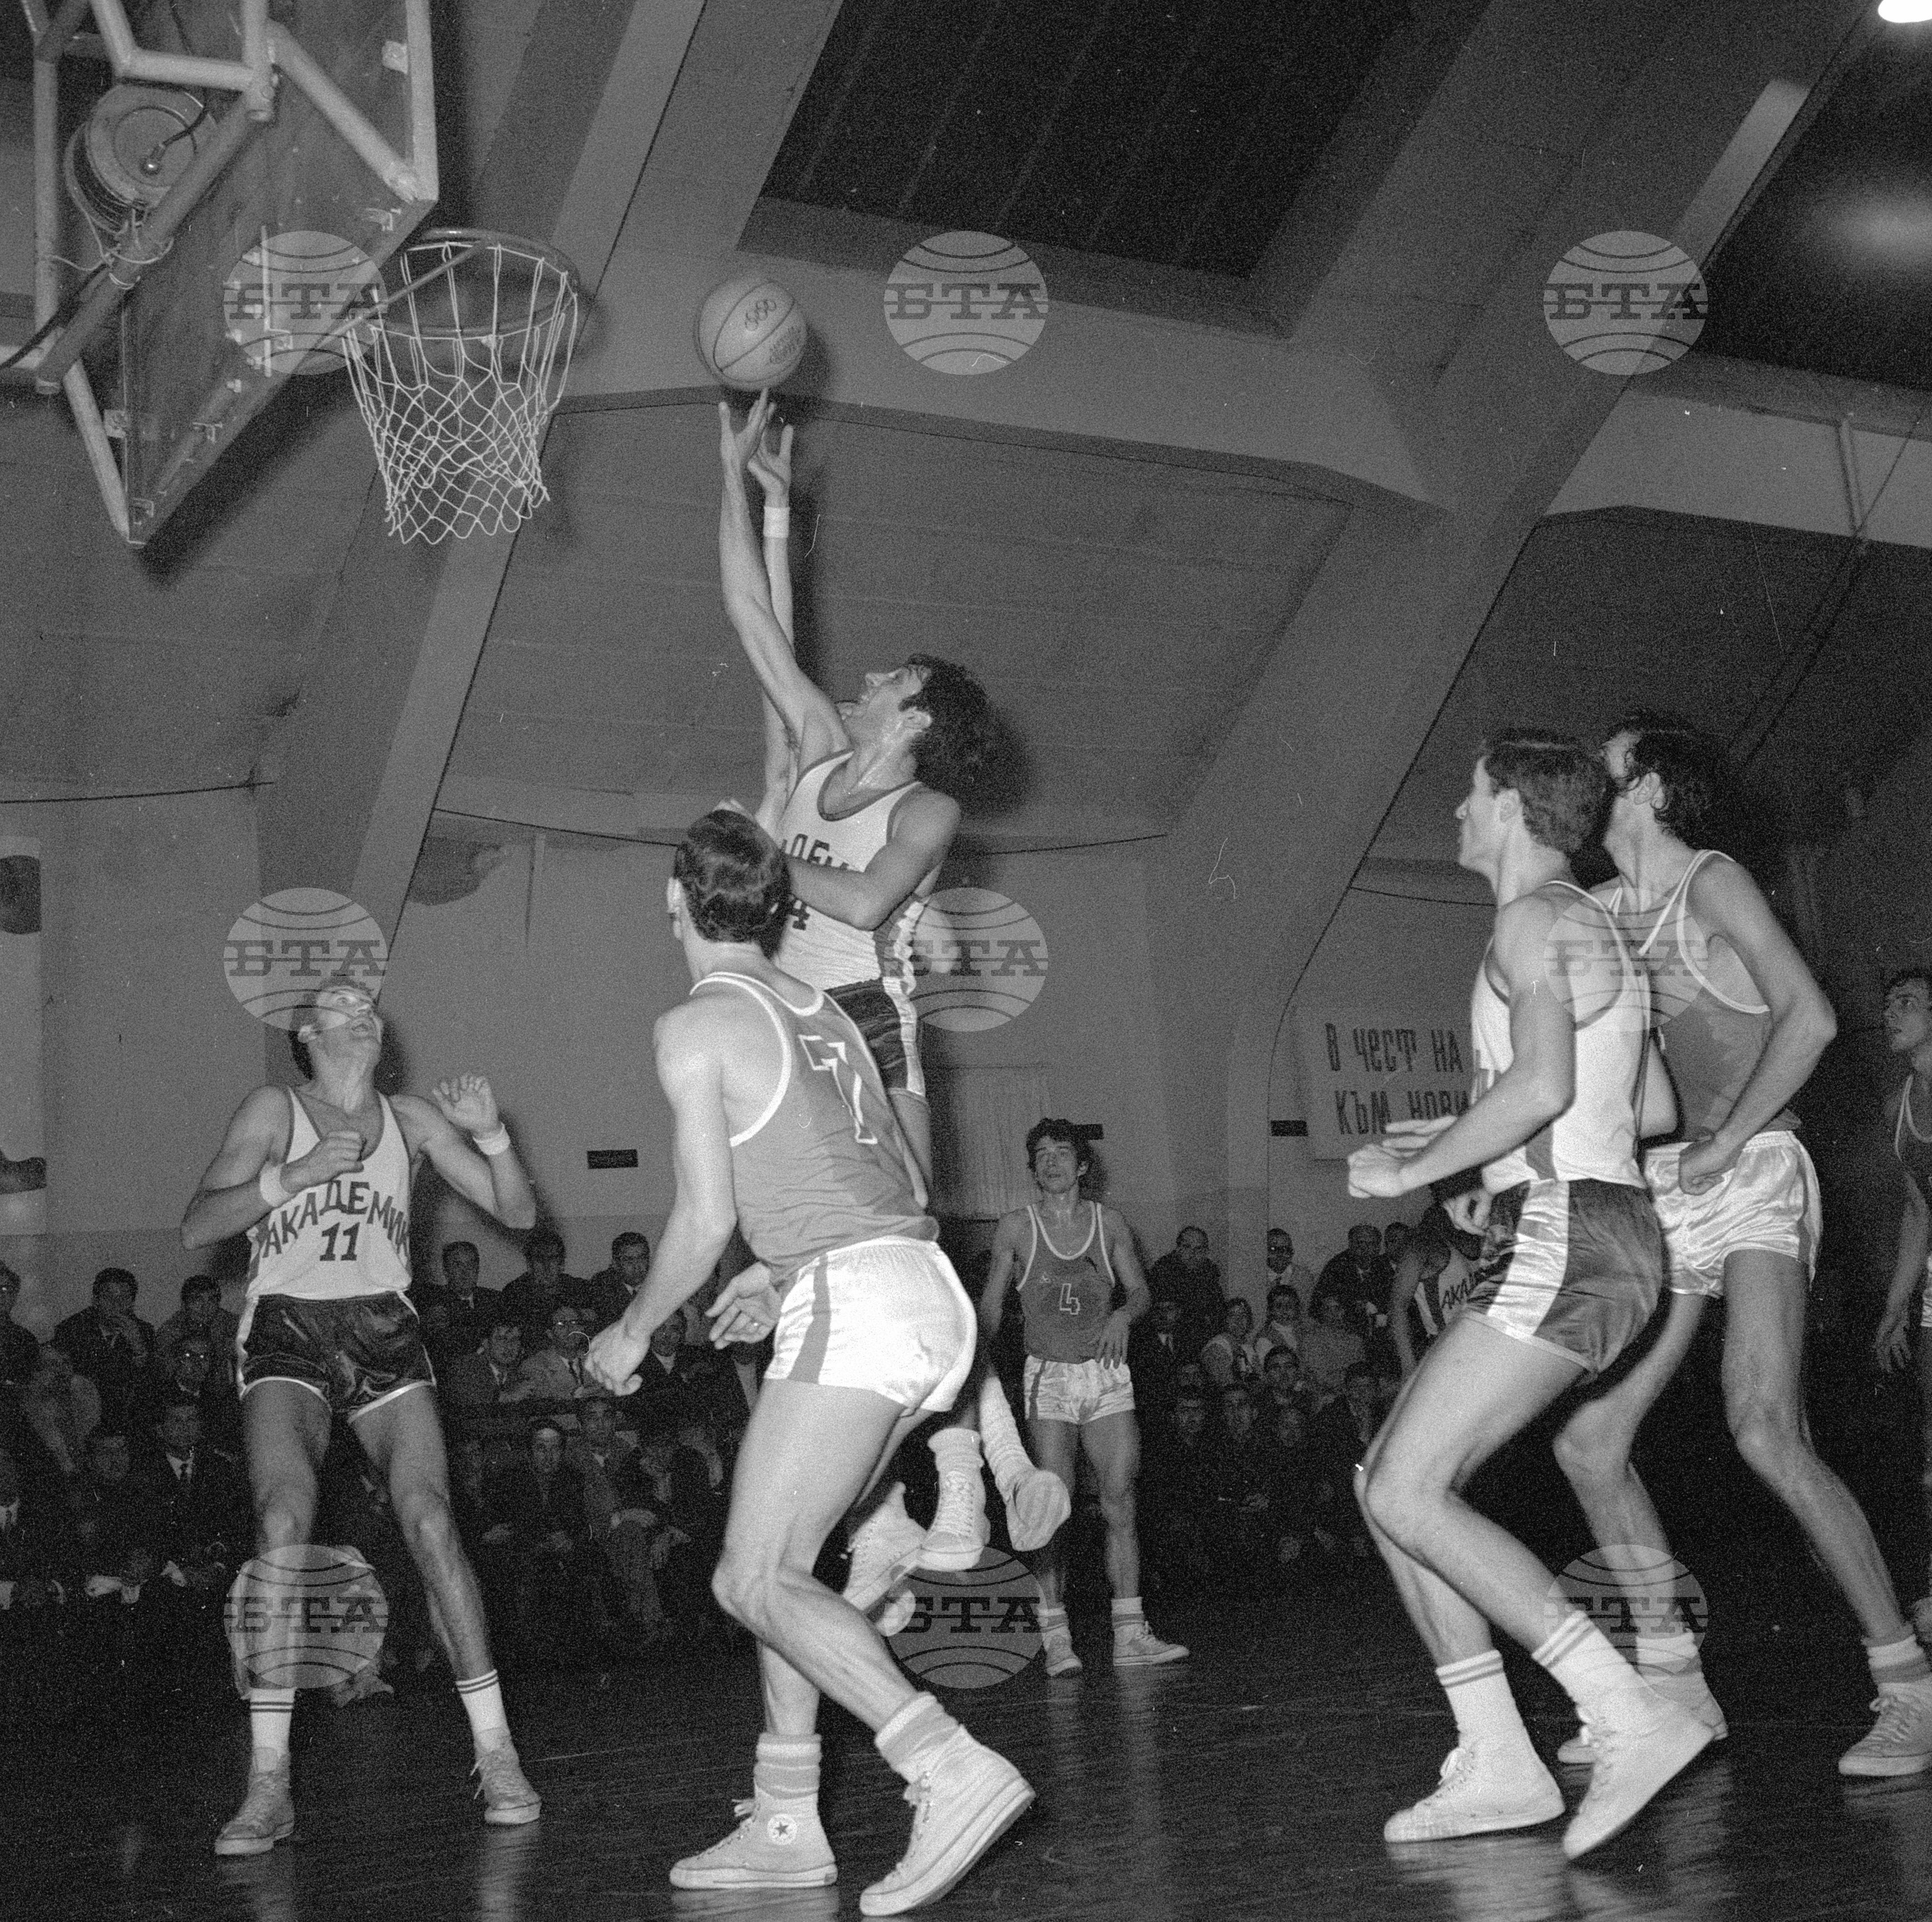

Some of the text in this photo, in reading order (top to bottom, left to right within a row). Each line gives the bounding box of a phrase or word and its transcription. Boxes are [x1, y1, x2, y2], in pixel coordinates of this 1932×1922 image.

[1431, 1029, 1463, 1073] НА
[798, 1034, 878, 1144] 7
[1334, 1090, 1392, 1135] КЪМ
[262, 1180, 411, 1258] АКАДЕМИК
[320, 1222, 360, 1262] 11
[1060, 1283, 1080, 1315] 4
